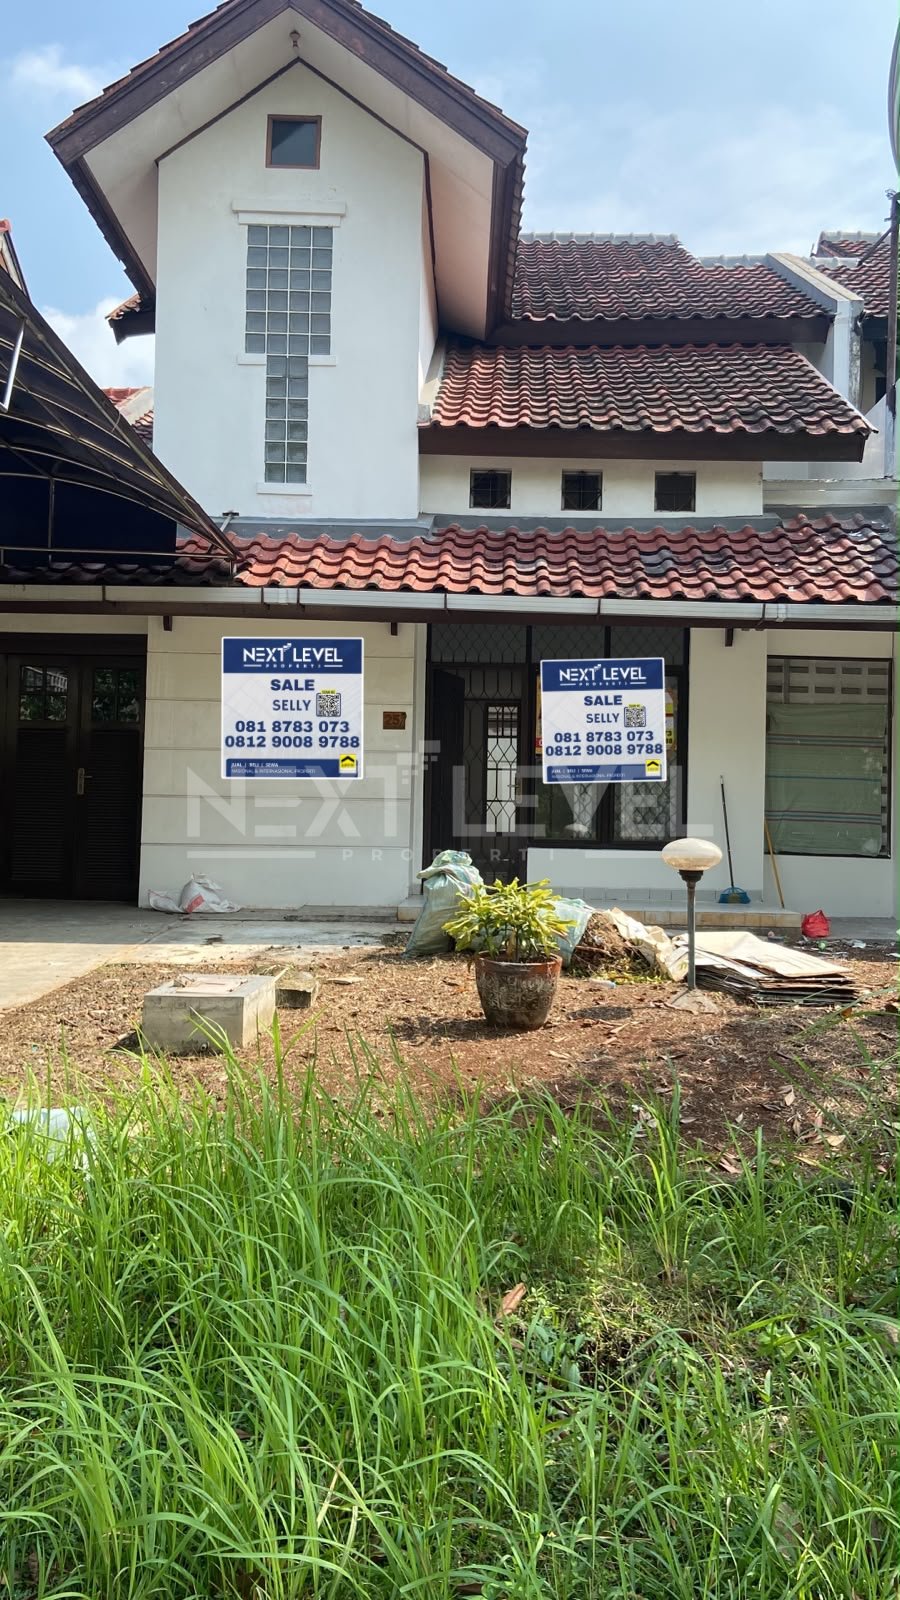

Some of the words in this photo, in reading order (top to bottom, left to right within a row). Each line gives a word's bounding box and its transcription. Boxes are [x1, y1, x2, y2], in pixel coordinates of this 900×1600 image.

[243, 647, 286, 662] NEXT
[293, 647, 343, 662] LEVEL
[559, 668, 596, 681] NEXT
[603, 667, 647, 681] LEVEL
[270, 679, 315, 691] SALE
[272, 699, 311, 711] SELLY
[584, 695, 623, 706] SALE
[586, 713, 620, 723] SELLY
[235, 721, 266, 732] 081
[272, 721, 313, 732] 8783
[319, 721, 350, 732] 073
[225, 736, 266, 748] 0812
[272, 736, 313, 748] 9008
[319, 736, 360, 748] 9788
[554, 732, 581, 743] 081
[586, 732, 622, 742] 8783
[627, 731, 654, 741] 073
[545, 745, 582, 756] 0812
[586, 744, 622, 755] 9008
[627, 743, 663, 754] 9788
